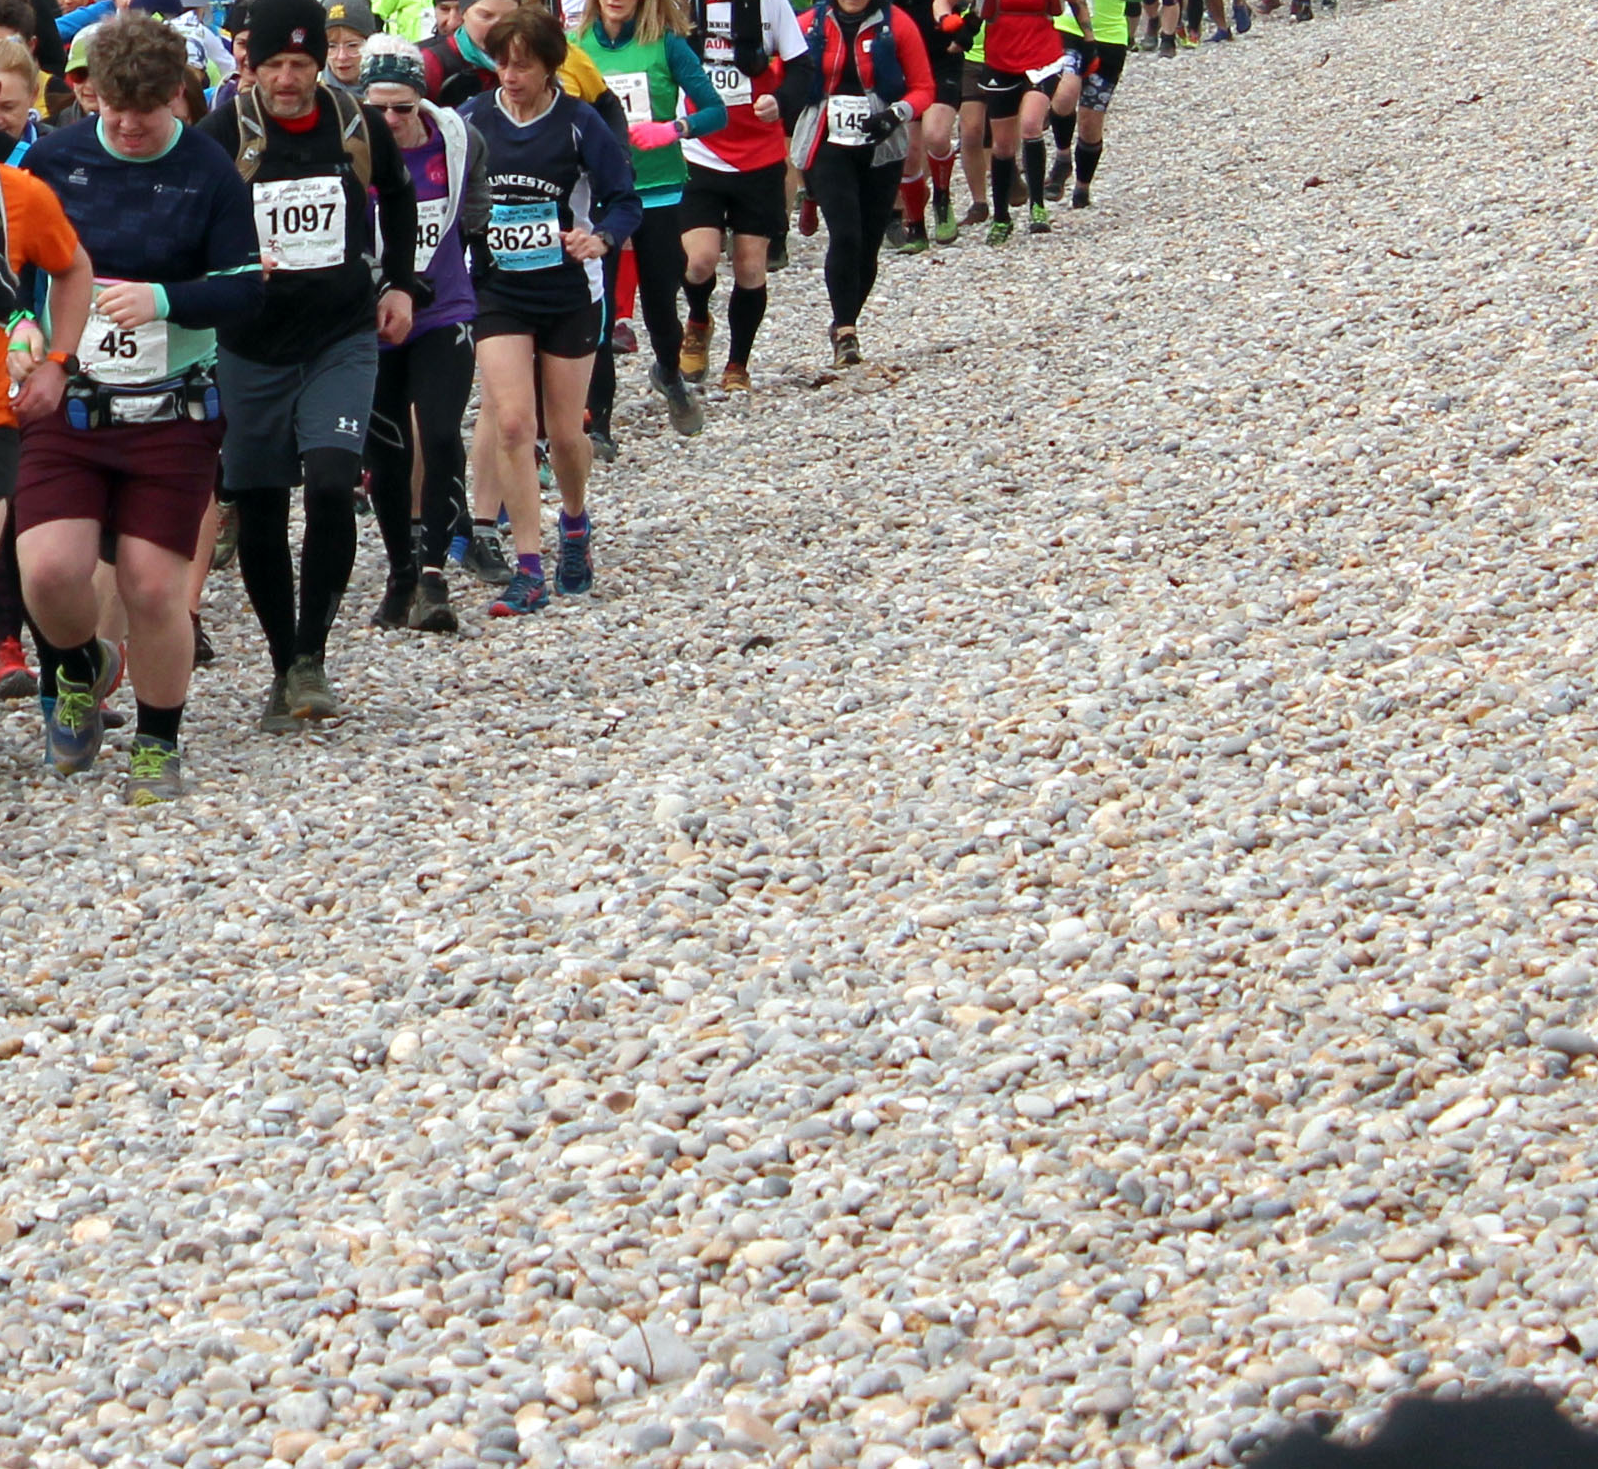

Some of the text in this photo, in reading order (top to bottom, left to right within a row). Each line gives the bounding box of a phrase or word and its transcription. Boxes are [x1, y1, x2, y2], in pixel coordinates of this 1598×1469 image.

[266, 203, 336, 235] 1097
[487, 223, 552, 251] 3623
[98, 330, 138, 359] 45
